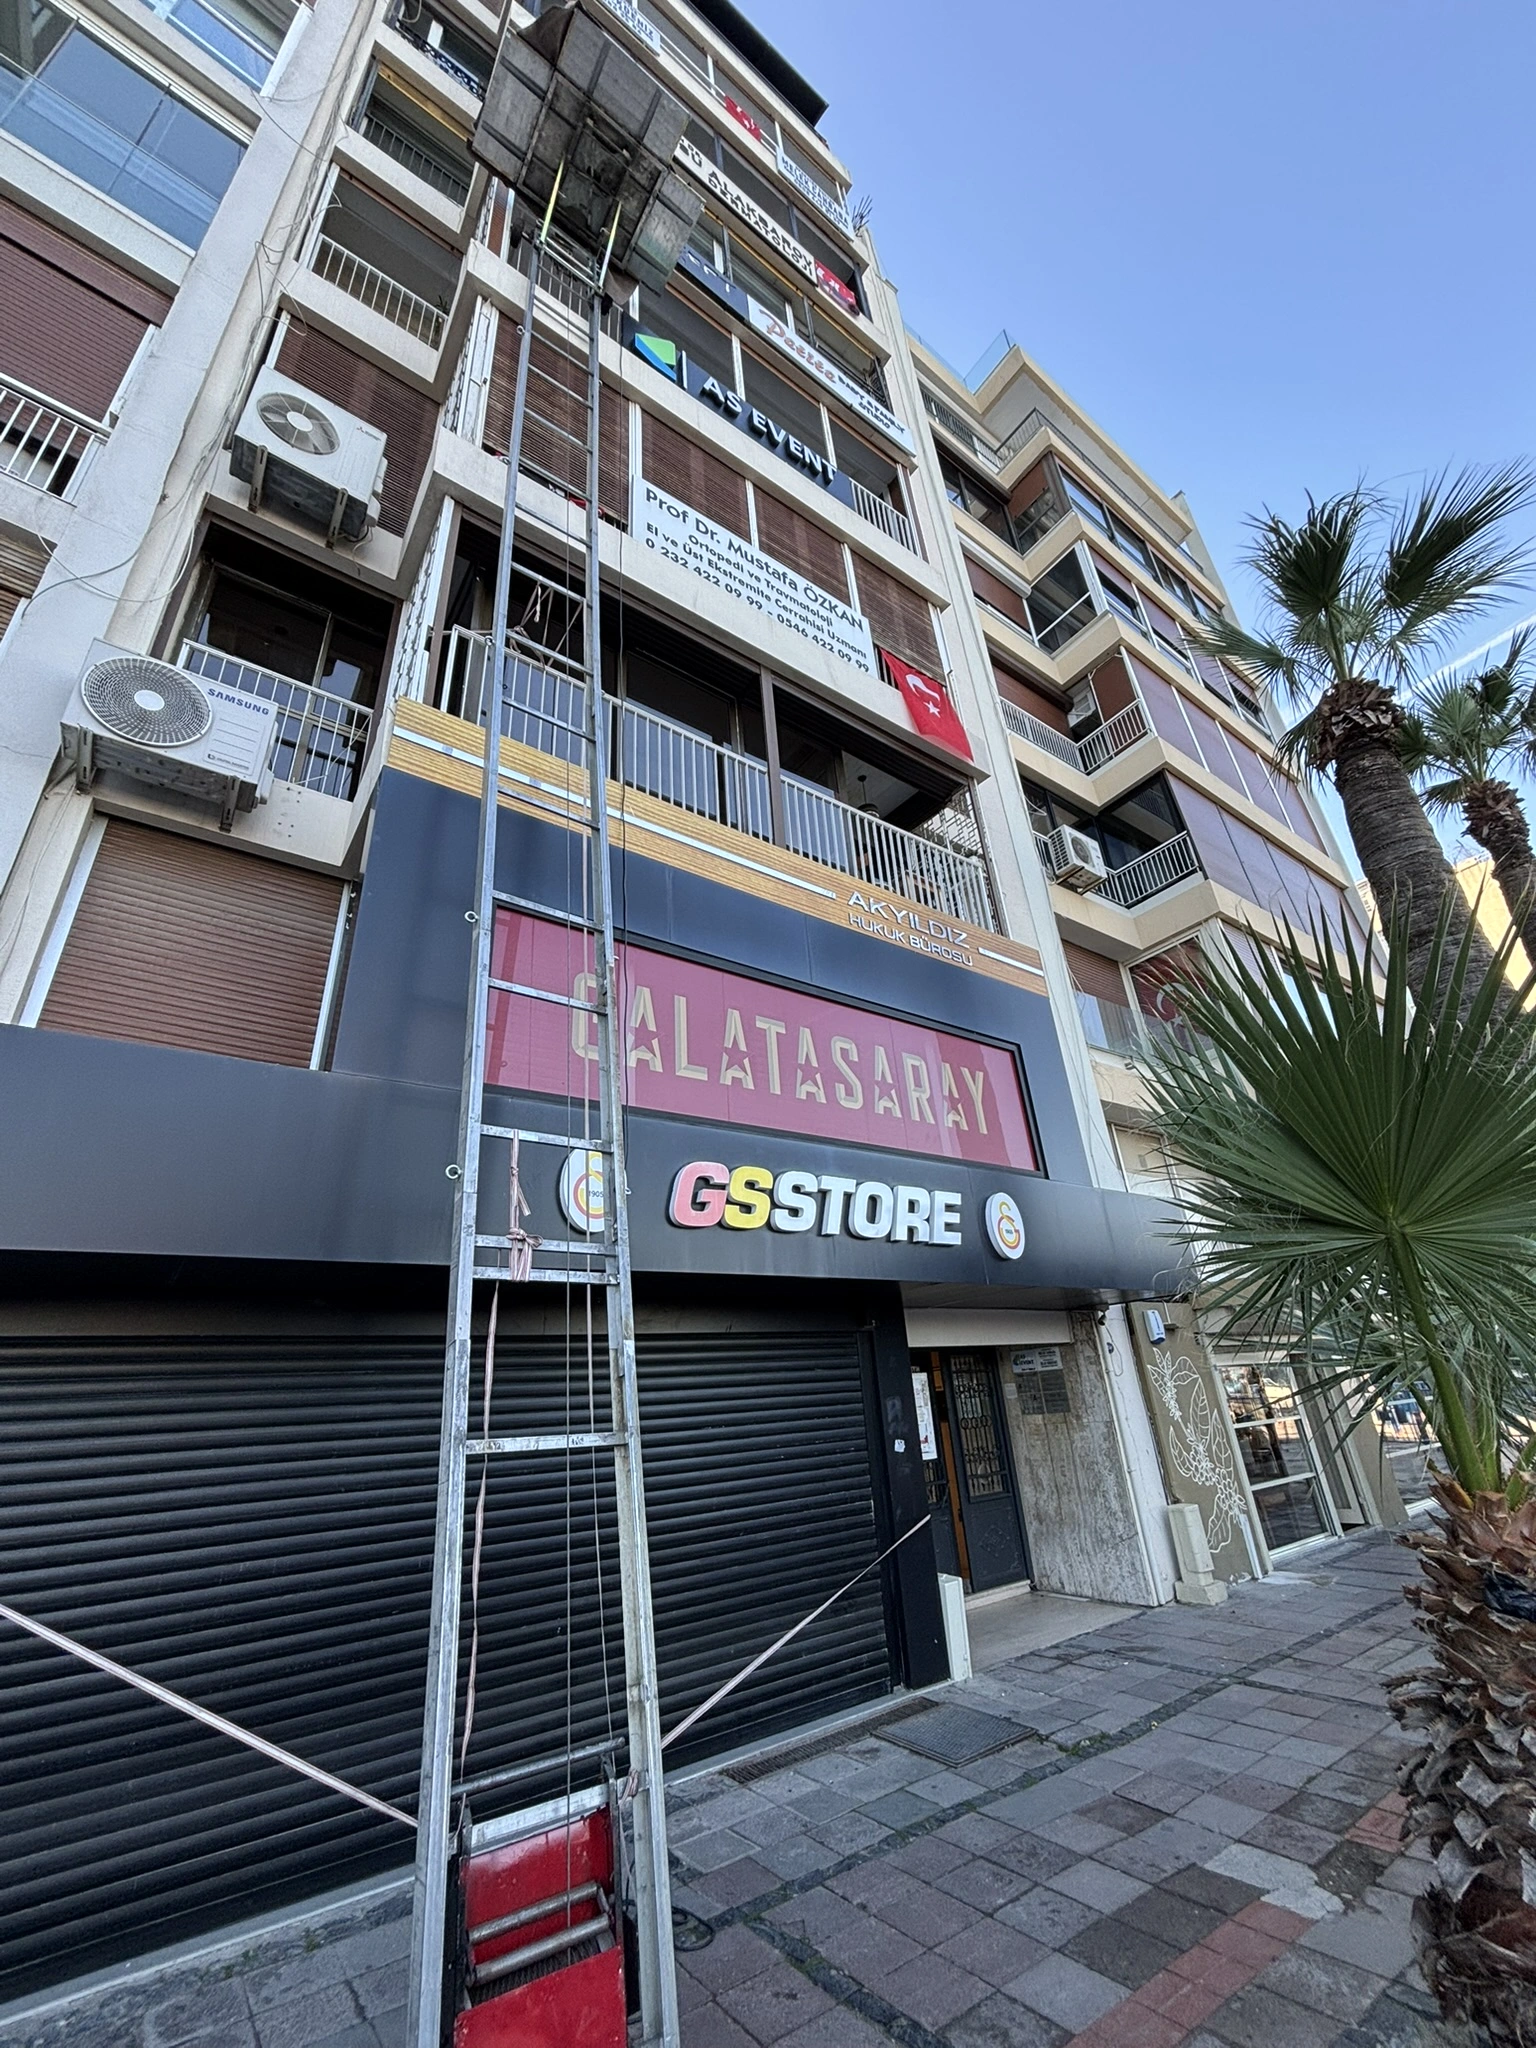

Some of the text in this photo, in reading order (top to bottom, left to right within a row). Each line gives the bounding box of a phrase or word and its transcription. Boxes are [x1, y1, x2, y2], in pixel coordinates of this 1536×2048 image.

[708, 170, 813, 267] ALAKBAROV
[701, 376, 838, 484] AS EVENT
[645, 538, 655, 549] 0
[660, 546, 689, 569] 232
[693, 565, 721, 588] 422
[724, 583, 742, 598] 09
[746, 595, 763, 610] 99
[777, 613, 808, 638] 0546
[812, 634, 835, 654] 422
[837, 649, 852, 663] 09
[855, 659, 870, 673] 99
[646, 487, 864, 633] Prof Dr. Mustafa ÖZKAN
[646, 521, 658, 537] El
[662, 533, 679, 548] ve
[683, 542, 703, 563] Üst
[707, 557, 771, 602] Ekstremite
[775, 598, 825, 634] Cerrahisi
[688, 534, 833, 627] Ortopedi ve Travmatoloji
[207, 688, 270, 716] SAMSUNG
[848, 891, 970, 949] AKYILDIZ
[849, 913, 973, 966] HUKUK BÜROSU
[571, 971, 989, 1135] GALATASARAY
